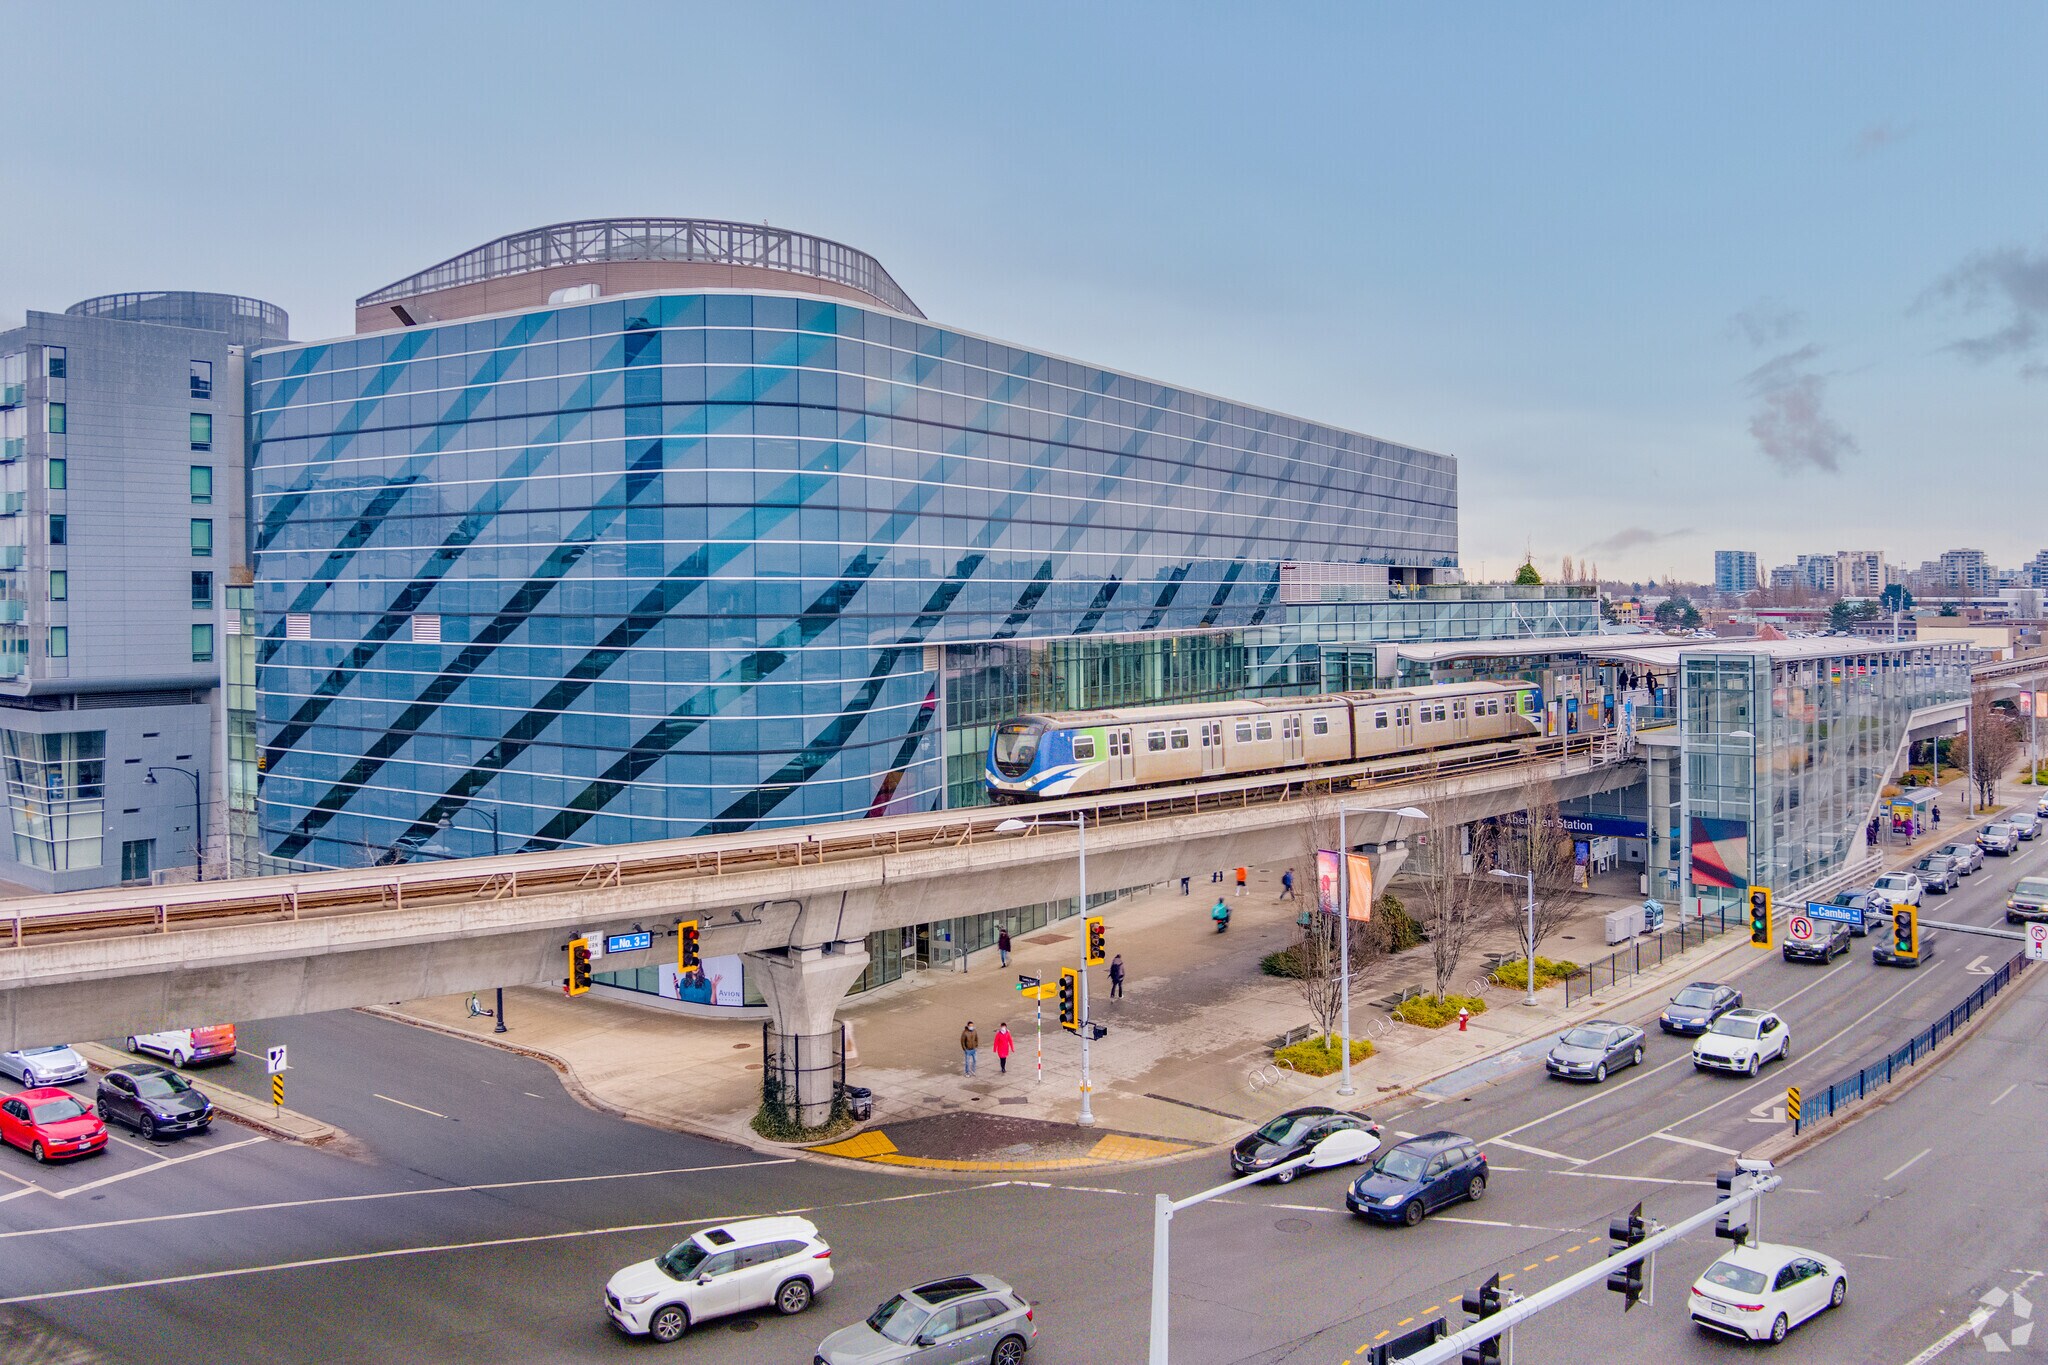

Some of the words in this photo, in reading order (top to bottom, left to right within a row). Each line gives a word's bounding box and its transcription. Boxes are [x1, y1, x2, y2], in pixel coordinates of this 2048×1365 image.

[1505, 814, 1554, 828] Aberden
[1557, 818, 1593, 831] Station
[1818, 907, 1850, 919] Cambie
[619, 938, 632, 948] No.
[634, 936, 640, 946] 3
